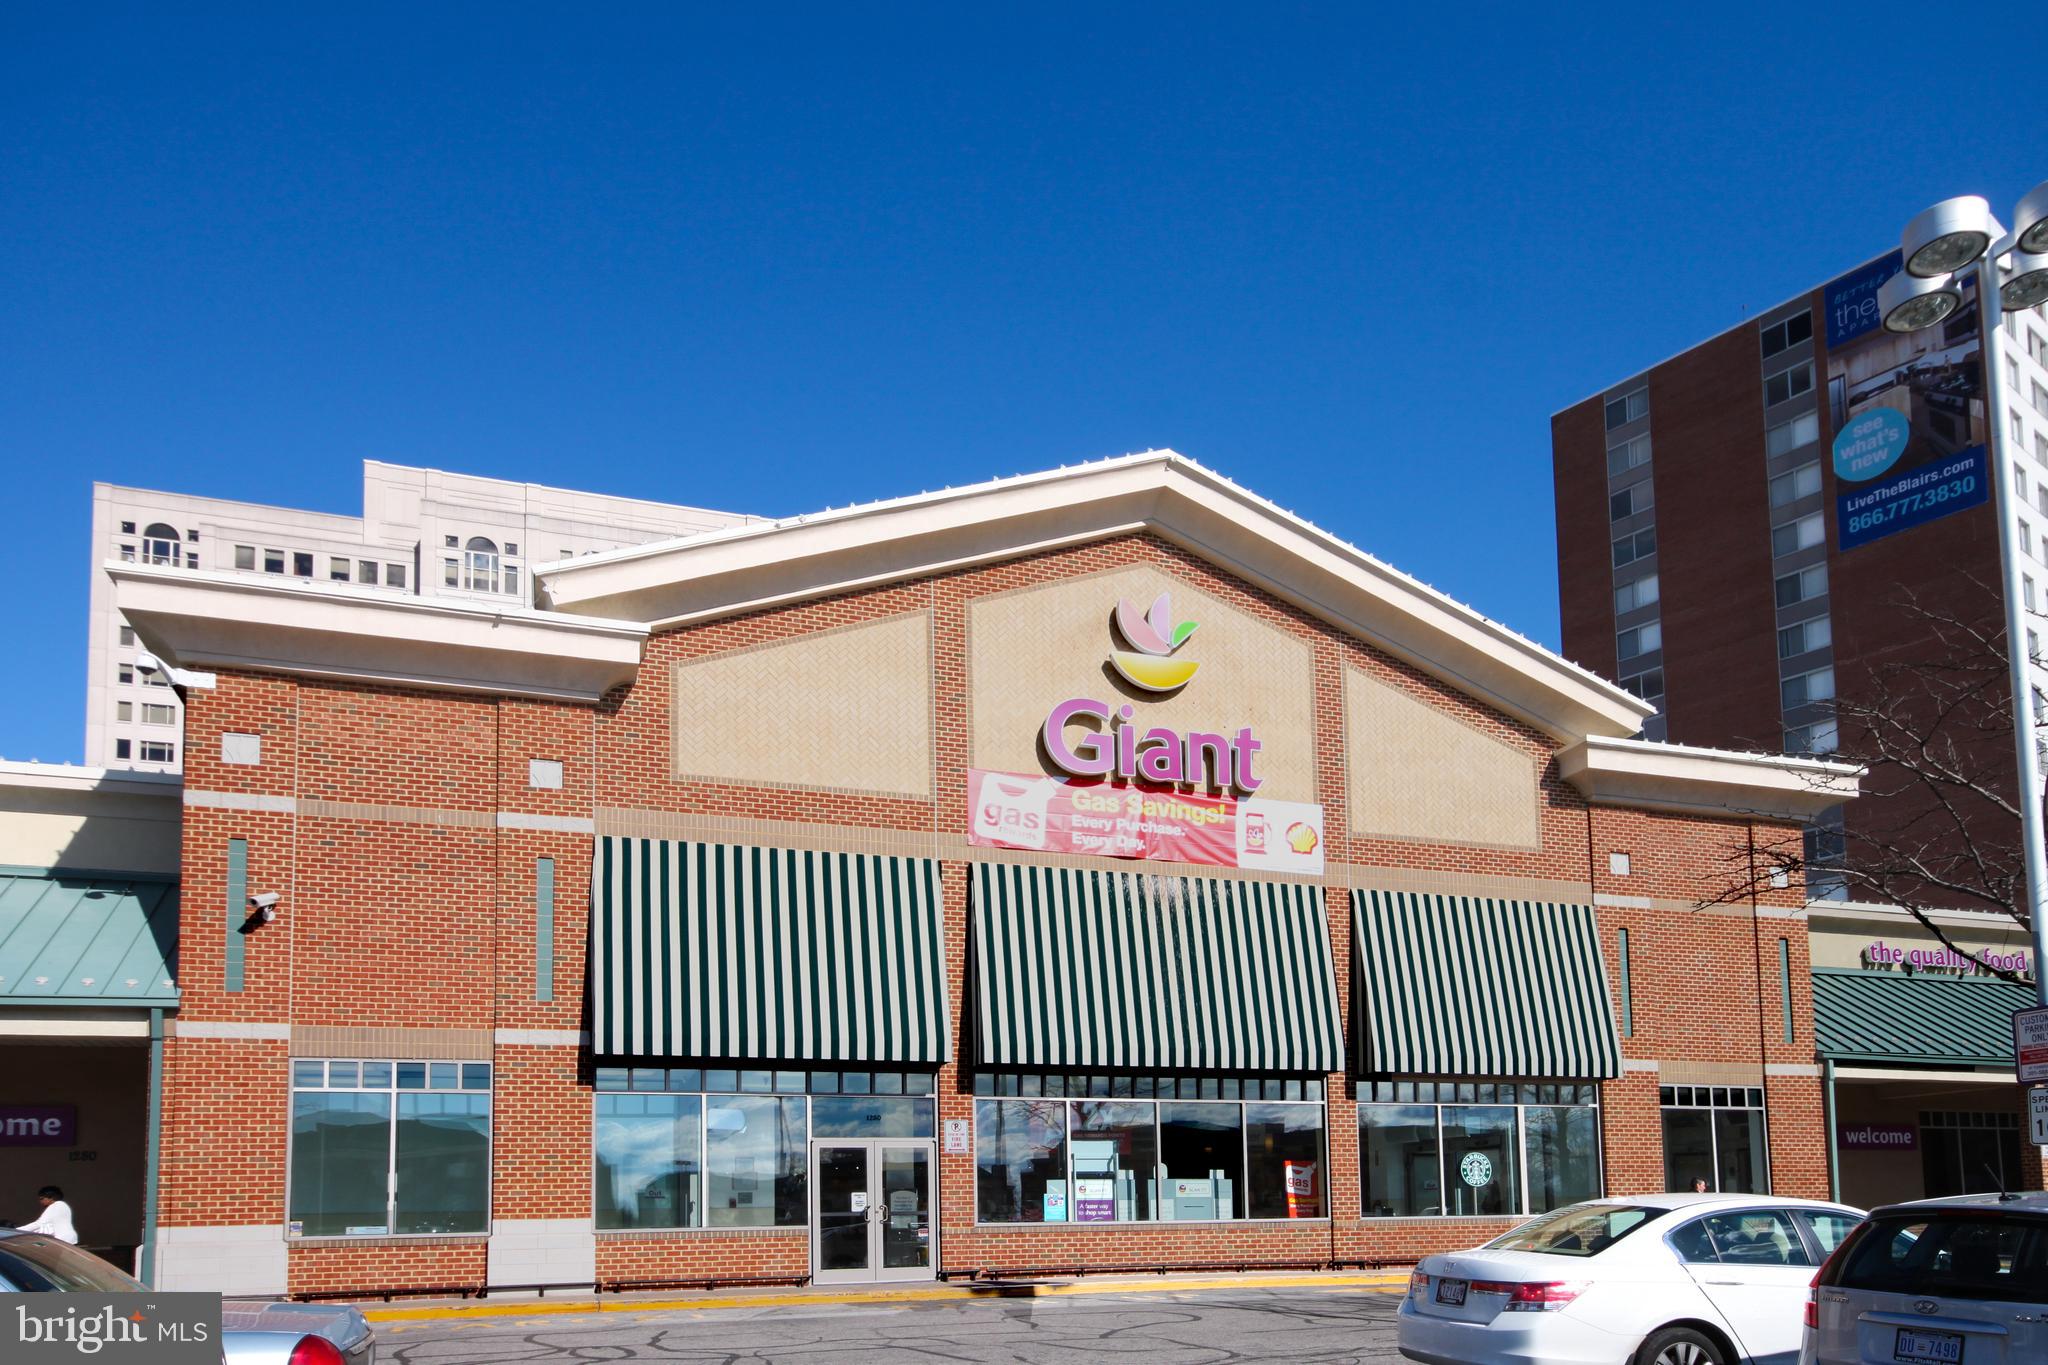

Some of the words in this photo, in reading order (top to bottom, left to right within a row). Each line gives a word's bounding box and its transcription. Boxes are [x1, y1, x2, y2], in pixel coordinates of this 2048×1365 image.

[1836, 298, 1876, 328] the
[1853, 416, 1883, 438] see
[1840, 428, 1899, 460] what's
[1852, 447, 1888, 472] new
[1847, 458, 1975, 512] LiveTheBlairs.com
[1848, 475, 1976, 533] 866.777.3830
[1043, 698, 1264, 792] Giant
[983, 802, 1040, 829] gas
[1071, 789, 1121, 812] Gas
[1128, 794, 1226, 826] Savings!
[1071, 814, 1112, 831] Every
[1116, 817, 1186, 836] Purchase.
[1071, 832, 1112, 848] Every
[1117, 834, 1146, 850] Day.
[1870, 941, 1903, 964] the
[1909, 945, 1976, 972] quality
[1983, 948, 2027, 971] food
[0, 1118, 62, 1135] me
[1846, 1127, 1912, 1144] welcome
[1462, 1153, 1490, 1169] STARBUCKS
[1287, 1177, 1309, 1188] gas
[1466, 1175, 1488, 1185] COFFEE
[1900, 1338, 1915, 1353] DU
[1929, 1340, 1958, 1358] 7498
